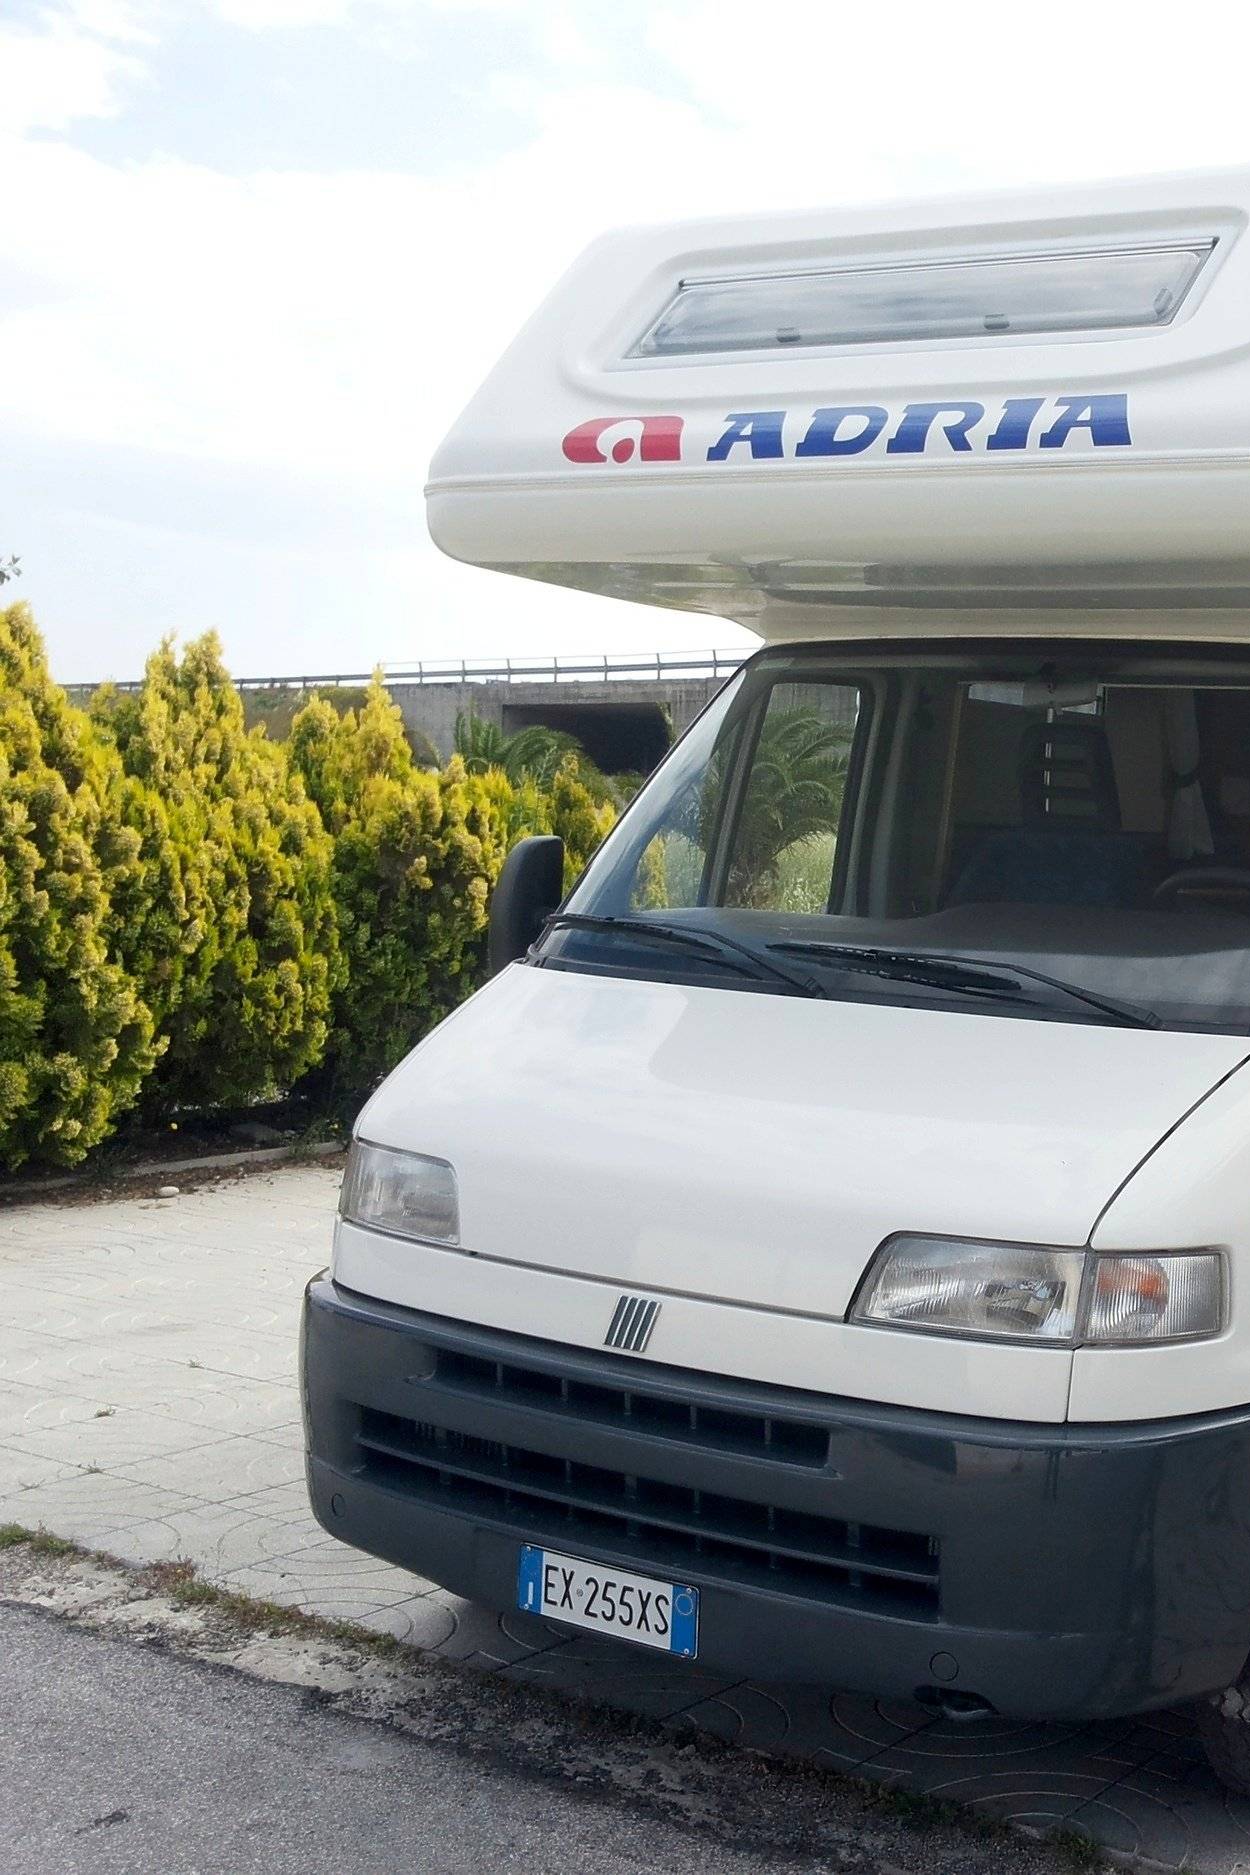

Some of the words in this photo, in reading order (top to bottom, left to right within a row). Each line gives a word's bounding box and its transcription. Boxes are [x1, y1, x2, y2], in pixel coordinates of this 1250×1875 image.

[705, 393, 1133, 462] ADRIA
[543, 1563, 576, 1611] EX
[584, 1576, 671, 1636] 255XS
